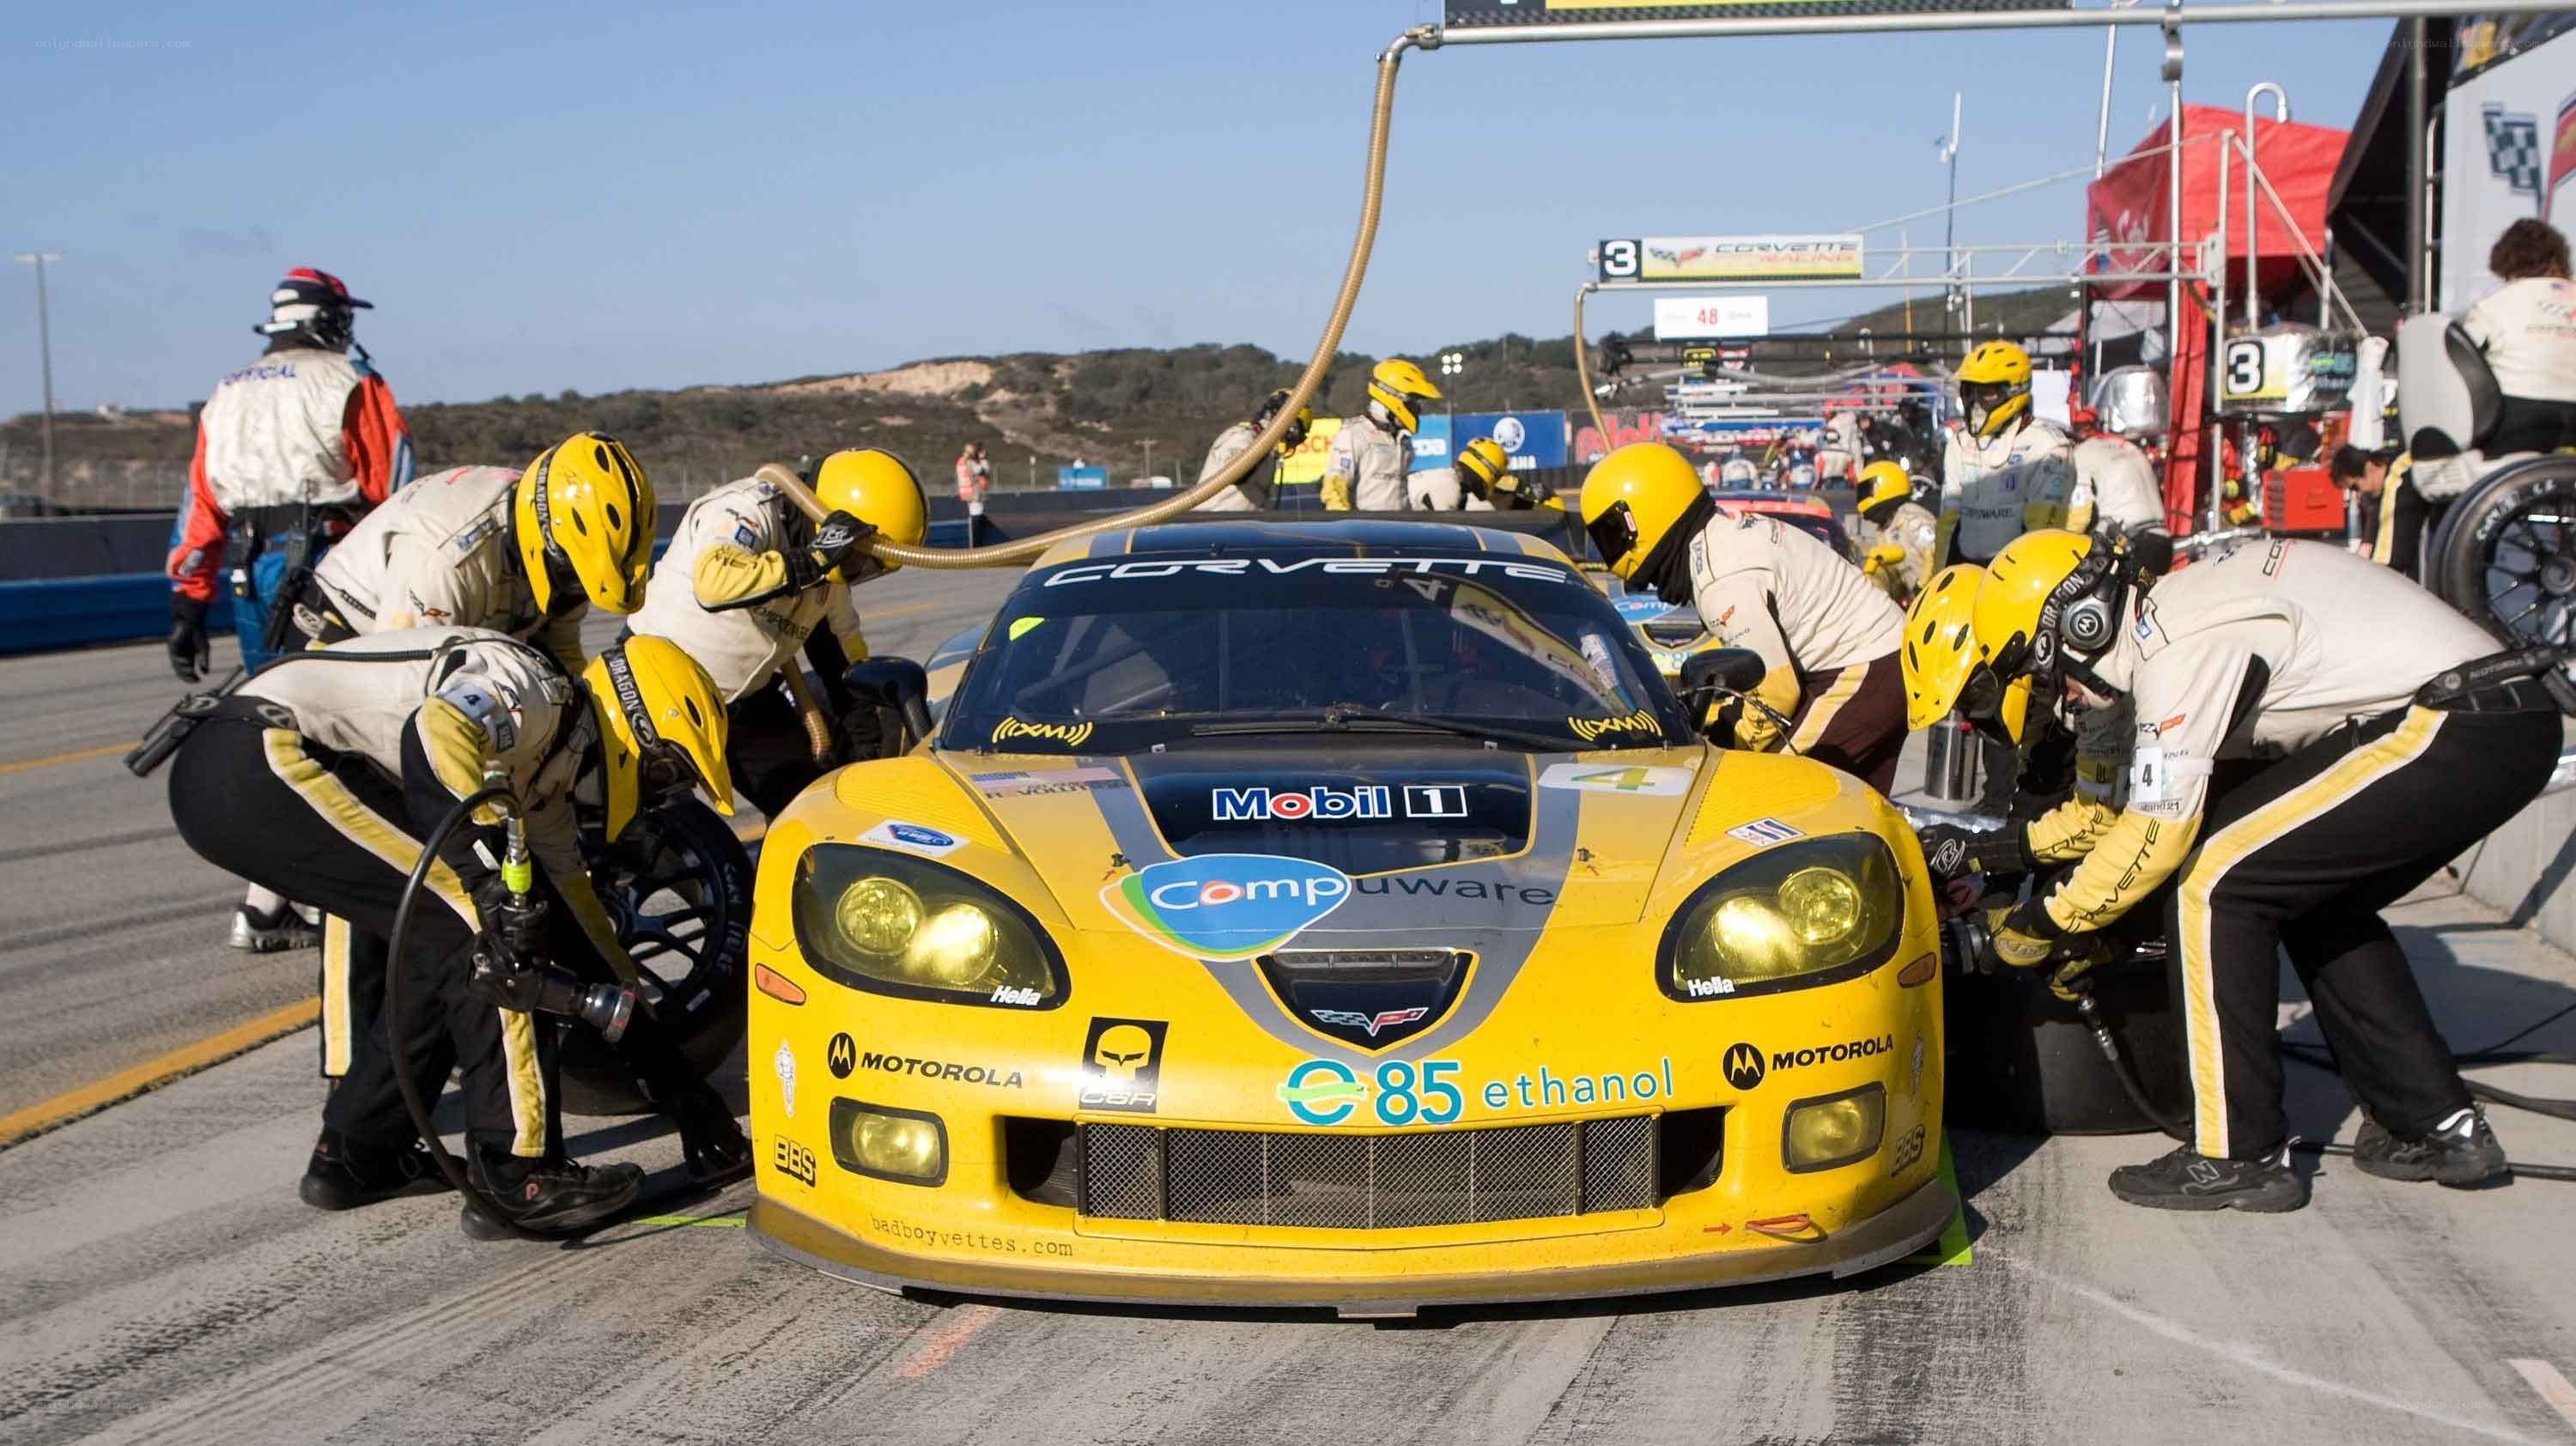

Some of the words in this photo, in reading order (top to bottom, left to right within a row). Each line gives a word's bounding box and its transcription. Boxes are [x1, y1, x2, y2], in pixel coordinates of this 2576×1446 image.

[1605, 240, 1637, 275] 3
[1715, 242, 1858, 253] CORVETTE
[1697, 308, 1718, 325] 48
[2228, 343, 2261, 393] 3
[1043, 557, 1567, 587] CORVETTE
[609, 657, 641, 711] DRAGON
[1571, 768, 1656, 790] 4
[2142, 763, 2153, 787] 4
[1212, 787, 1391, 820] Mobil
[990, 985, 1042, 1006] Hella
[1687, 975, 1735, 997] Hella
[1771, 1033, 1893, 1071] MOTOROLA
[861, 1053, 1024, 1088] MOTOROLA
[1485, 1058, 1673, 1108] ethanol
[774, 1134, 816, 1186] BBS
[871, 1214, 1073, 1257] badboyvettes.com
